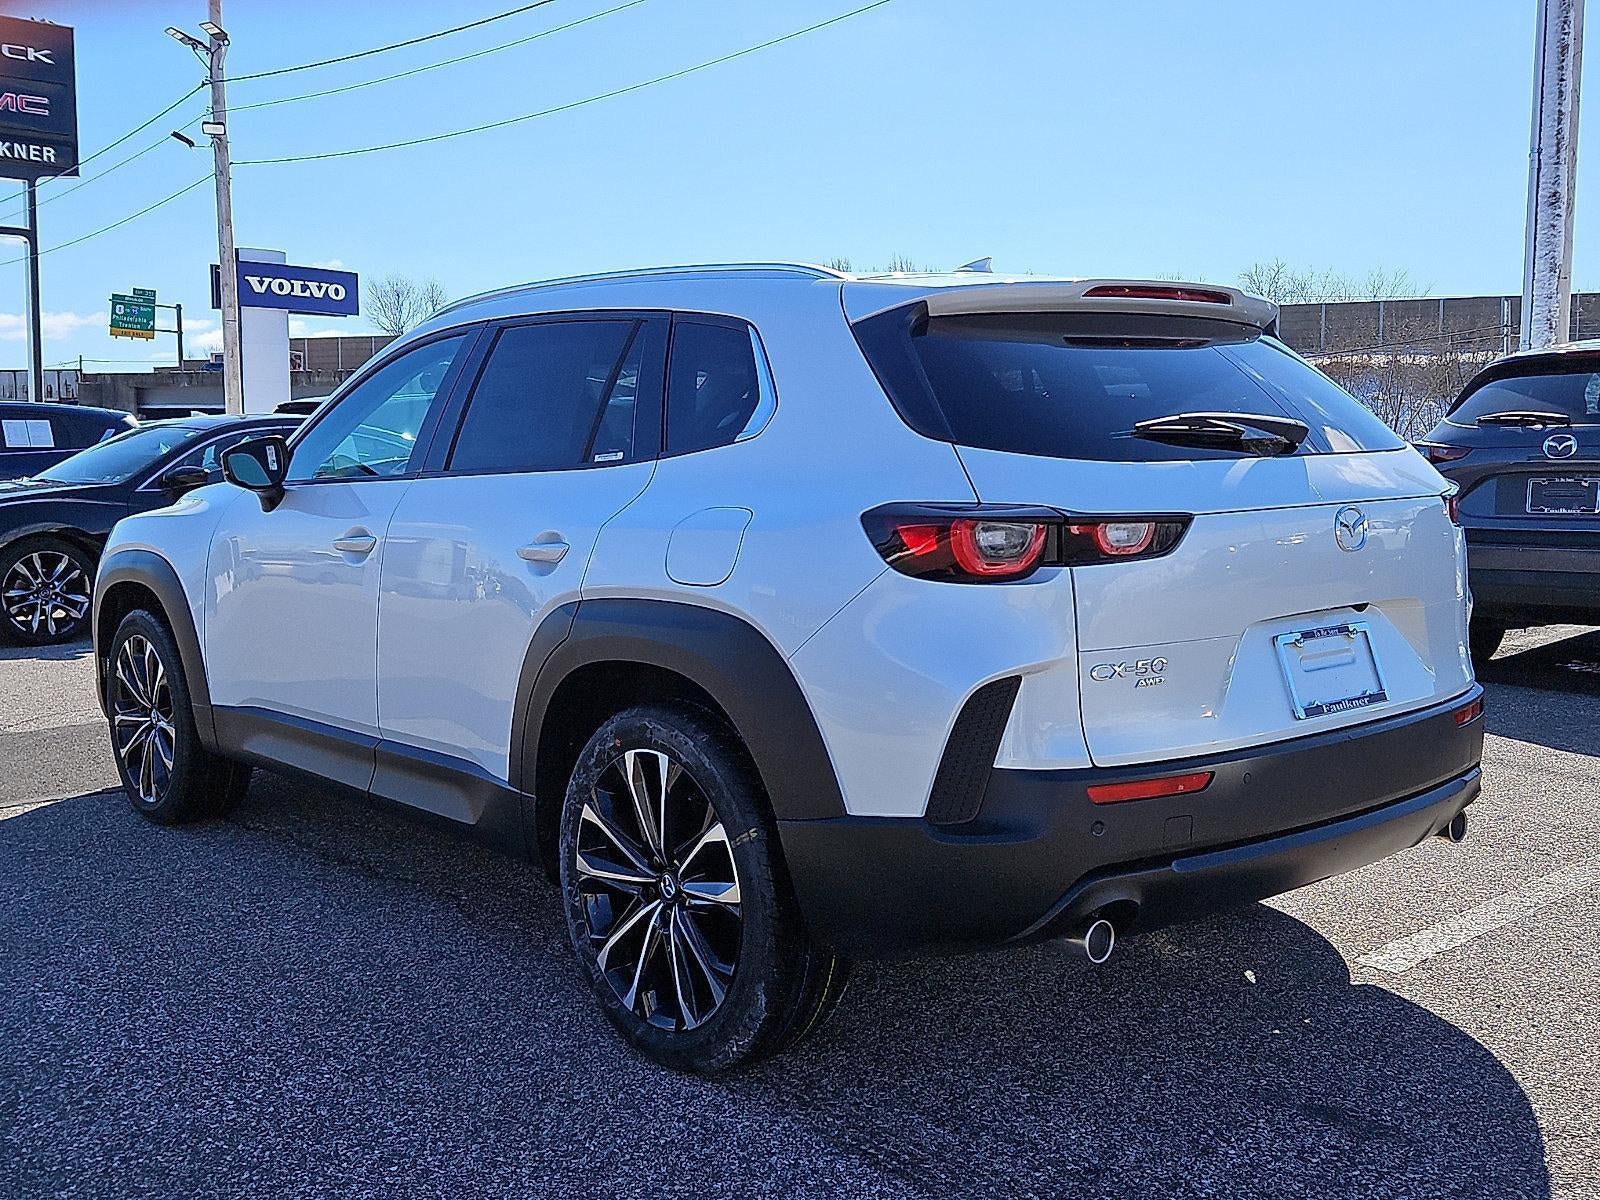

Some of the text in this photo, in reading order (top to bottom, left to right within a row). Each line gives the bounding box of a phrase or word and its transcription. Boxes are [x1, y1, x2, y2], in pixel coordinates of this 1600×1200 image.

[244, 275, 346, 301] VOLVO
[1090, 656, 1168, 682] CX-50
[1134, 676, 1166, 688] AWD
[1322, 697, 1370, 713] Faulkner
